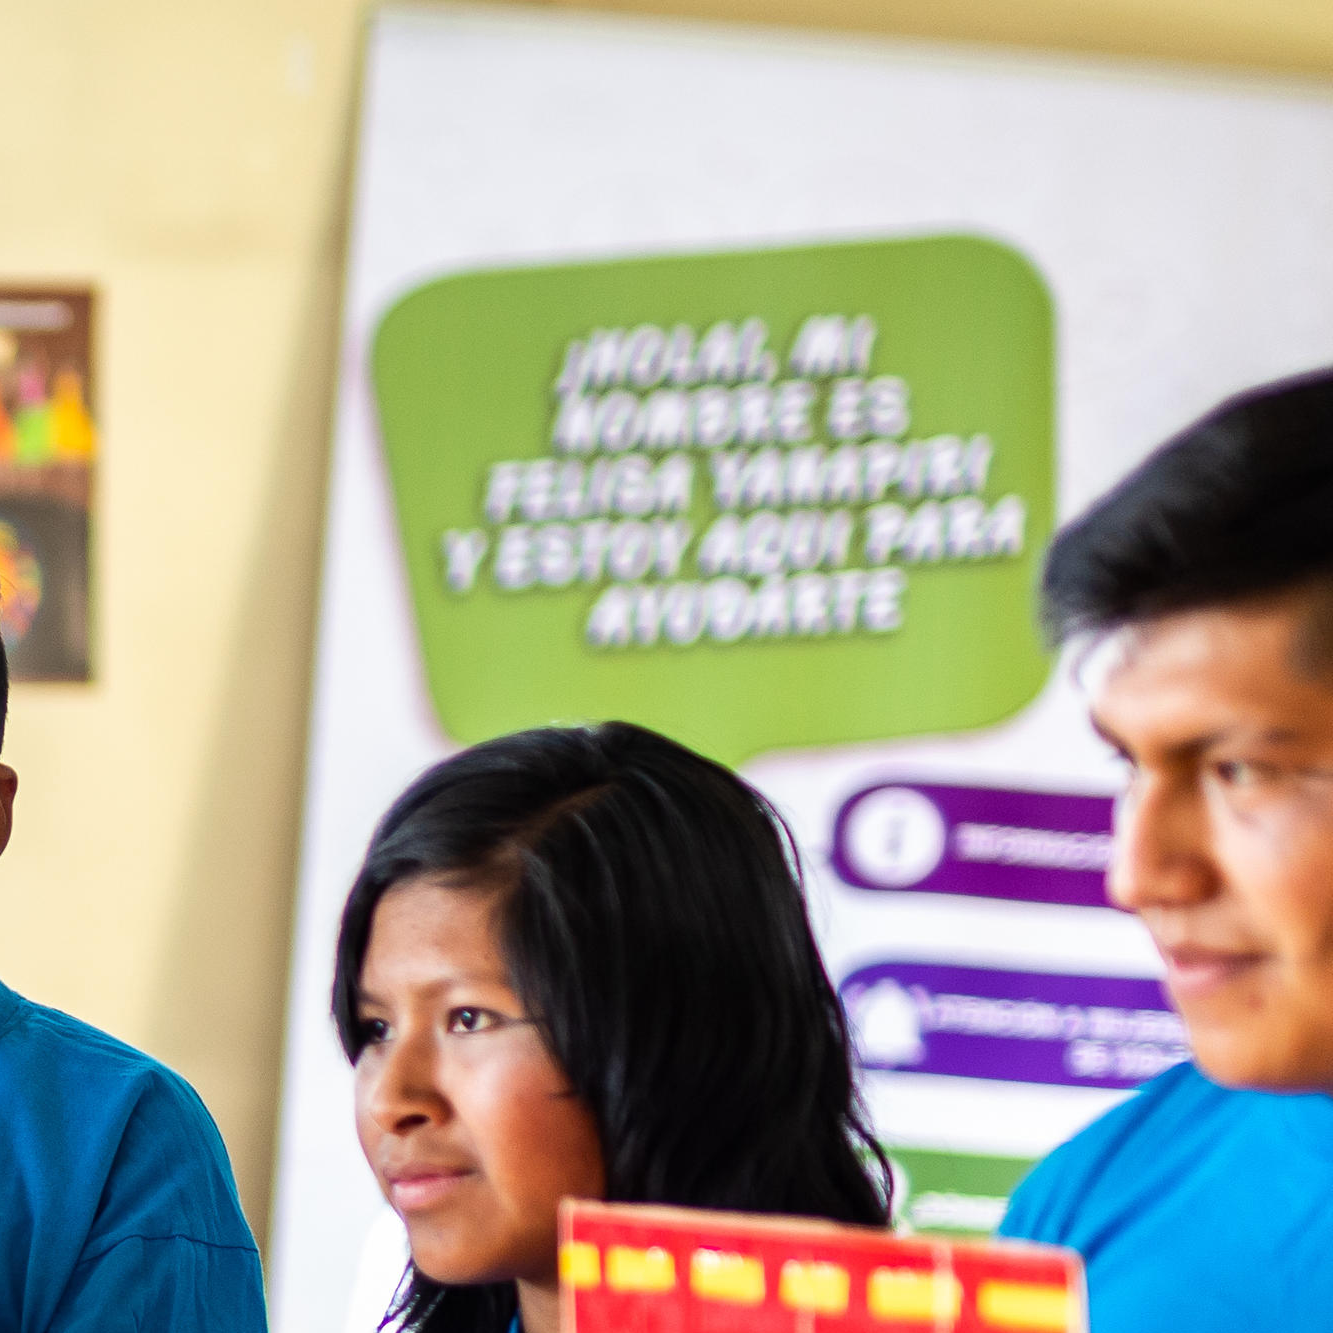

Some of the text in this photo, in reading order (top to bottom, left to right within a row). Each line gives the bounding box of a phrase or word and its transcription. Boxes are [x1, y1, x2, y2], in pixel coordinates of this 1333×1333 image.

[554, 376, 910, 453] NOMBRE ES
[485, 453, 695, 523] FELISA
[443, 528, 488, 592] Y
[493, 518, 692, 590] ESTOY
[864, 493, 1027, 563] PARA
[586, 568, 906, 647] AYUDARTE
